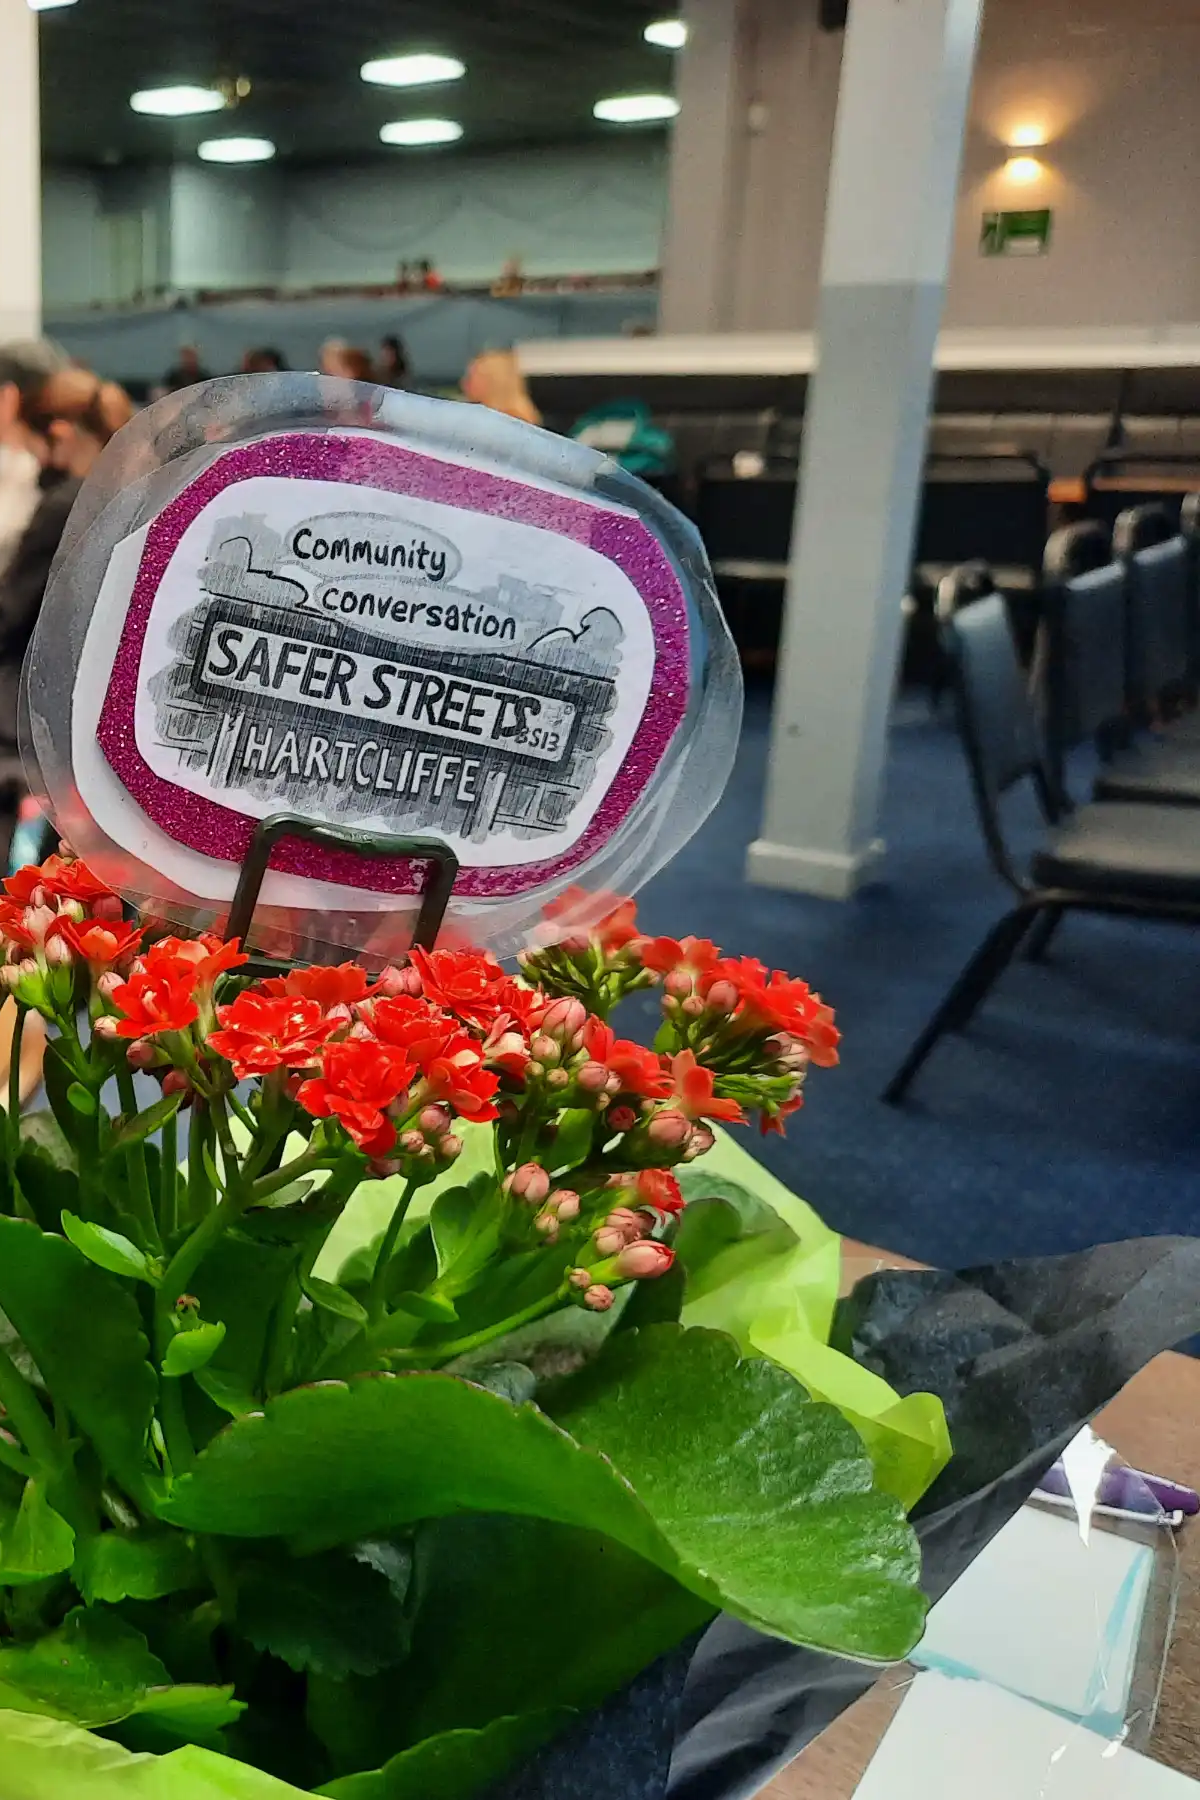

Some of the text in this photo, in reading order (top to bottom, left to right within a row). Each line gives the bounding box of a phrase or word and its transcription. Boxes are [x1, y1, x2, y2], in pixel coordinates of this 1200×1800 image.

[292, 527, 446, 582] Community
[207, 630, 542, 741] SAFER STREETS
[242, 724, 482, 802] HARTCLIFFE
